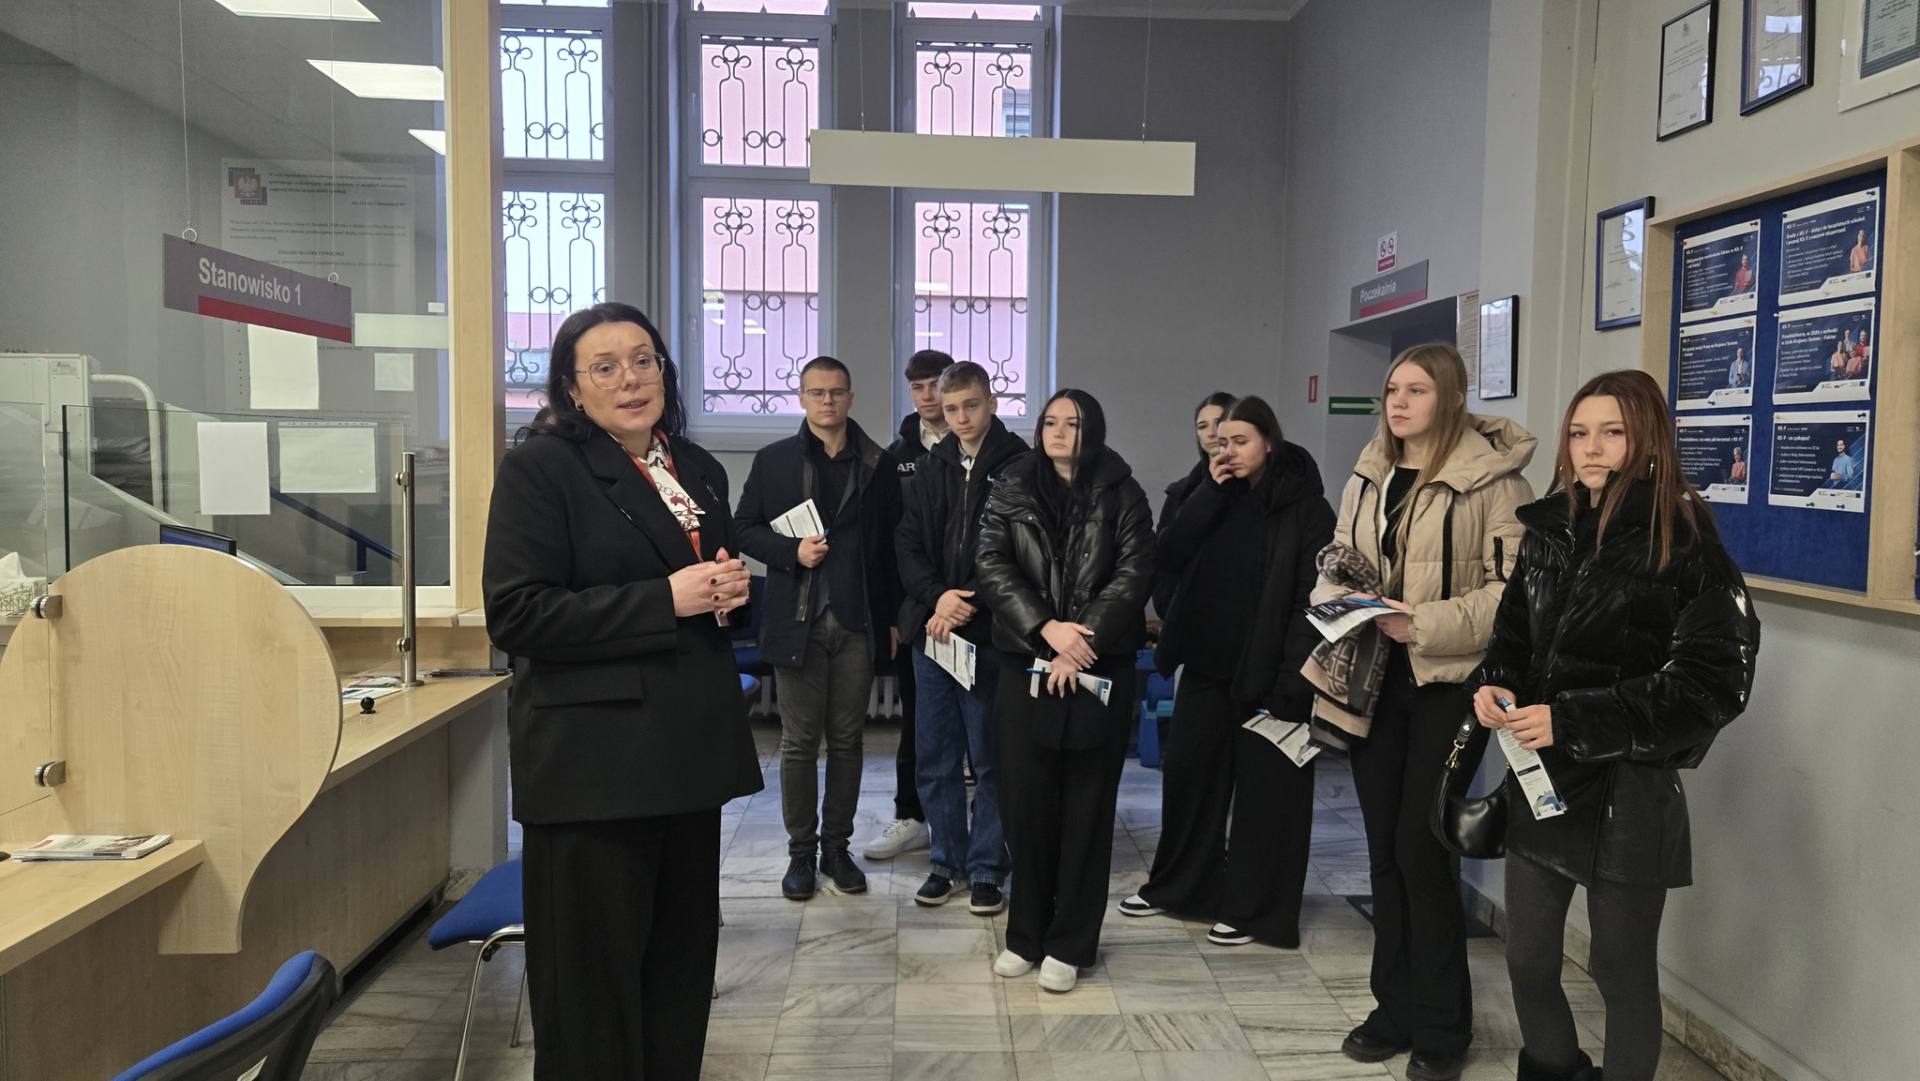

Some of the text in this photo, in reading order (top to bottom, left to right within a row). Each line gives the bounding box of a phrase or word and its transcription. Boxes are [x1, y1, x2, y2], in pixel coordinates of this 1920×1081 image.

[199, 257, 301, 306] Stanowisko 1
[1360, 280, 1396, 303] Poczekalnia
